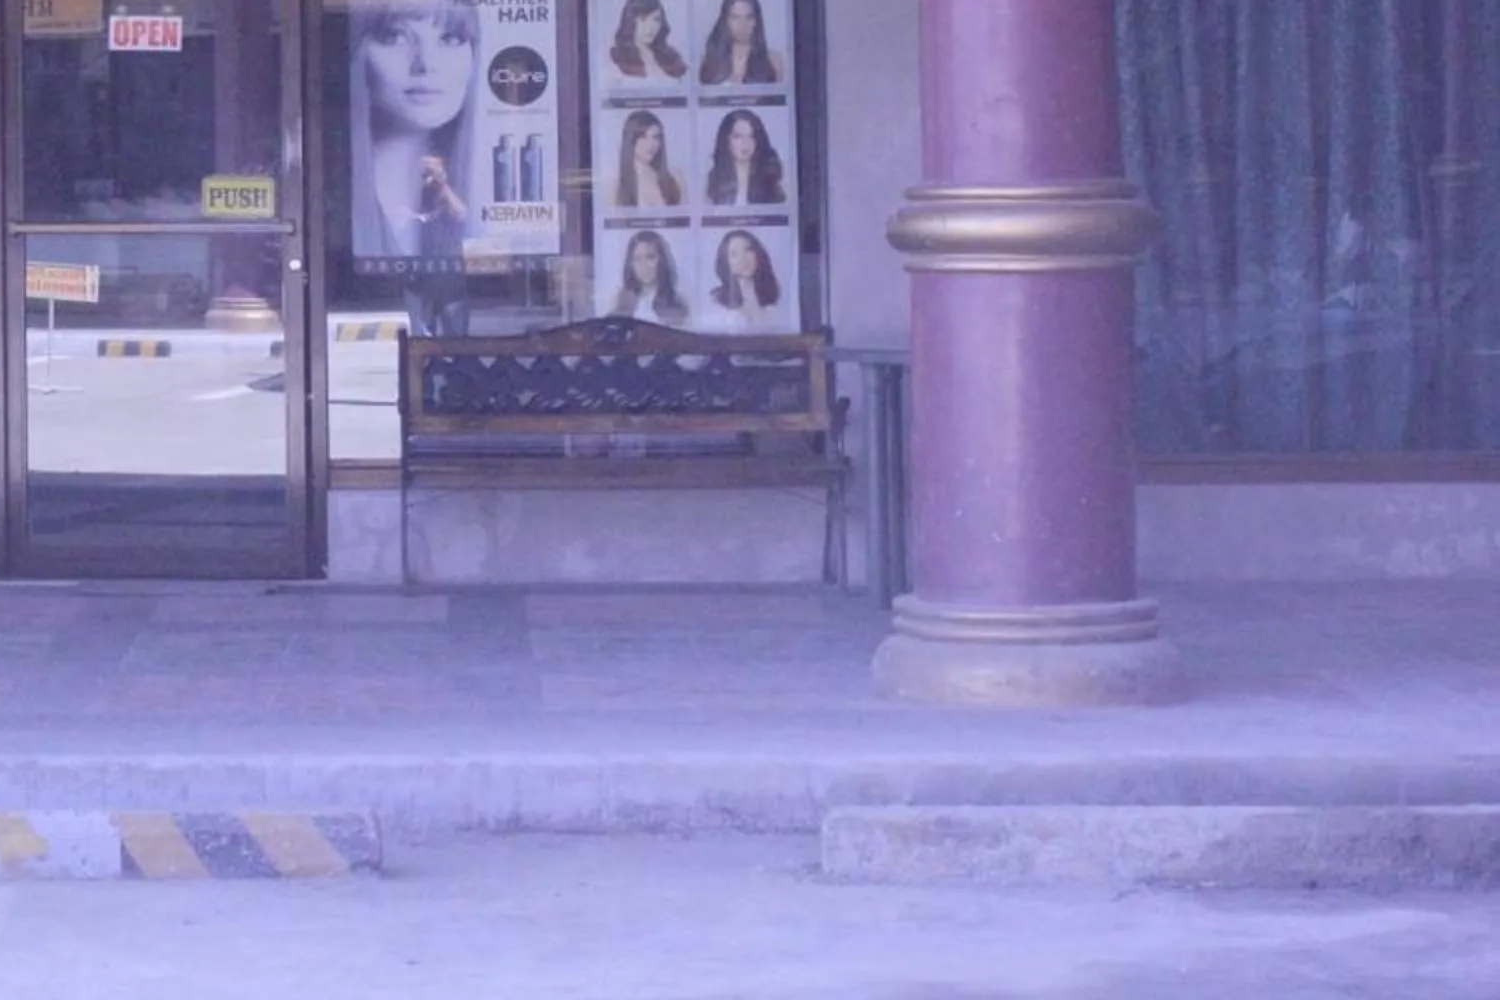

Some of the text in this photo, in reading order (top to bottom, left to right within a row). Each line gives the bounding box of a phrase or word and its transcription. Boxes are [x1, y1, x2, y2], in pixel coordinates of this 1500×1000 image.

[499, 7, 549, 23] HAIR
[113, 19, 178, 47] OPEN
[209, 187, 267, 209] PUSH
[481, 205, 554, 221] KERATIN
